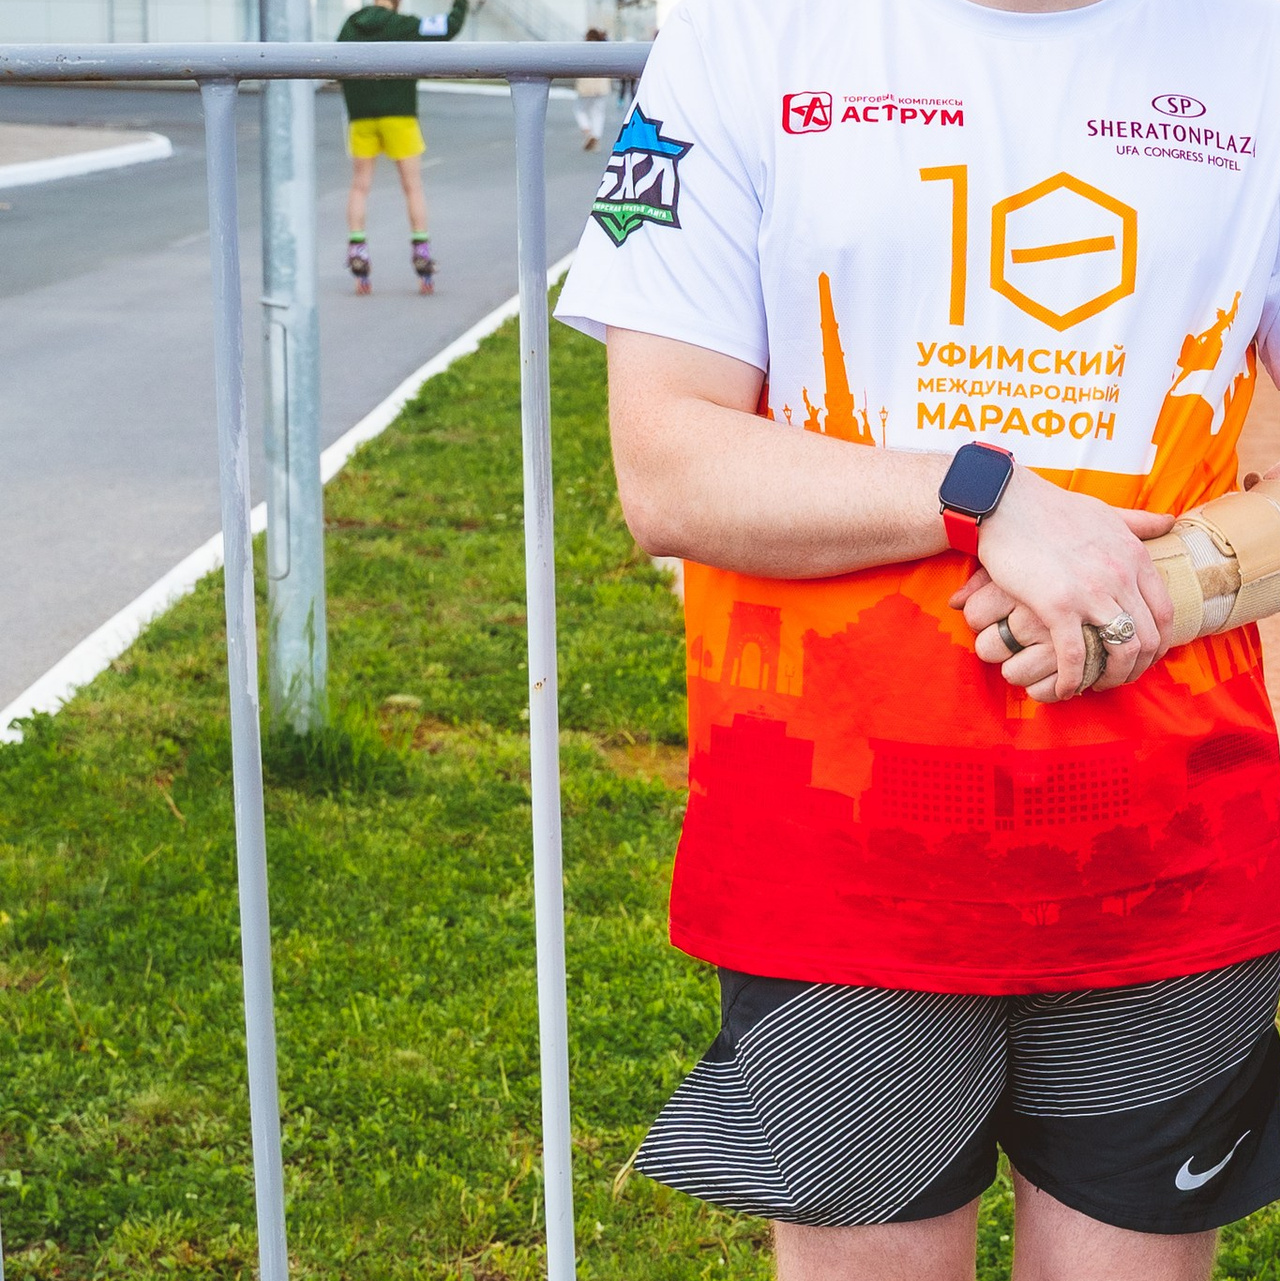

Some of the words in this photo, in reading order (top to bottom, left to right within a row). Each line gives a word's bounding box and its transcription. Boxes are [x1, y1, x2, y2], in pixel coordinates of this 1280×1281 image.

[843, 93, 895, 103] ТОРГОВЫЕ
[898, 97, 963, 107] КОМПЛЕКСЫ
[1167, 97, 1192, 114] SP
[841, 104, 964, 127] АСТРУМ
[1087, 119, 1257, 158] SHERATONPLAZ
[1116, 145, 1140, 156] UFA
[1143, 146, 1204, 163] CONGRESS
[1207, 154, 1241, 171] HOTEL
[916, 341, 1126, 377] УФИМСКИЙ
[917, 377, 1120, 404] МЕЖДУНАРОДНЫЙ
[917, 402, 1116, 441] МАРАФОН
